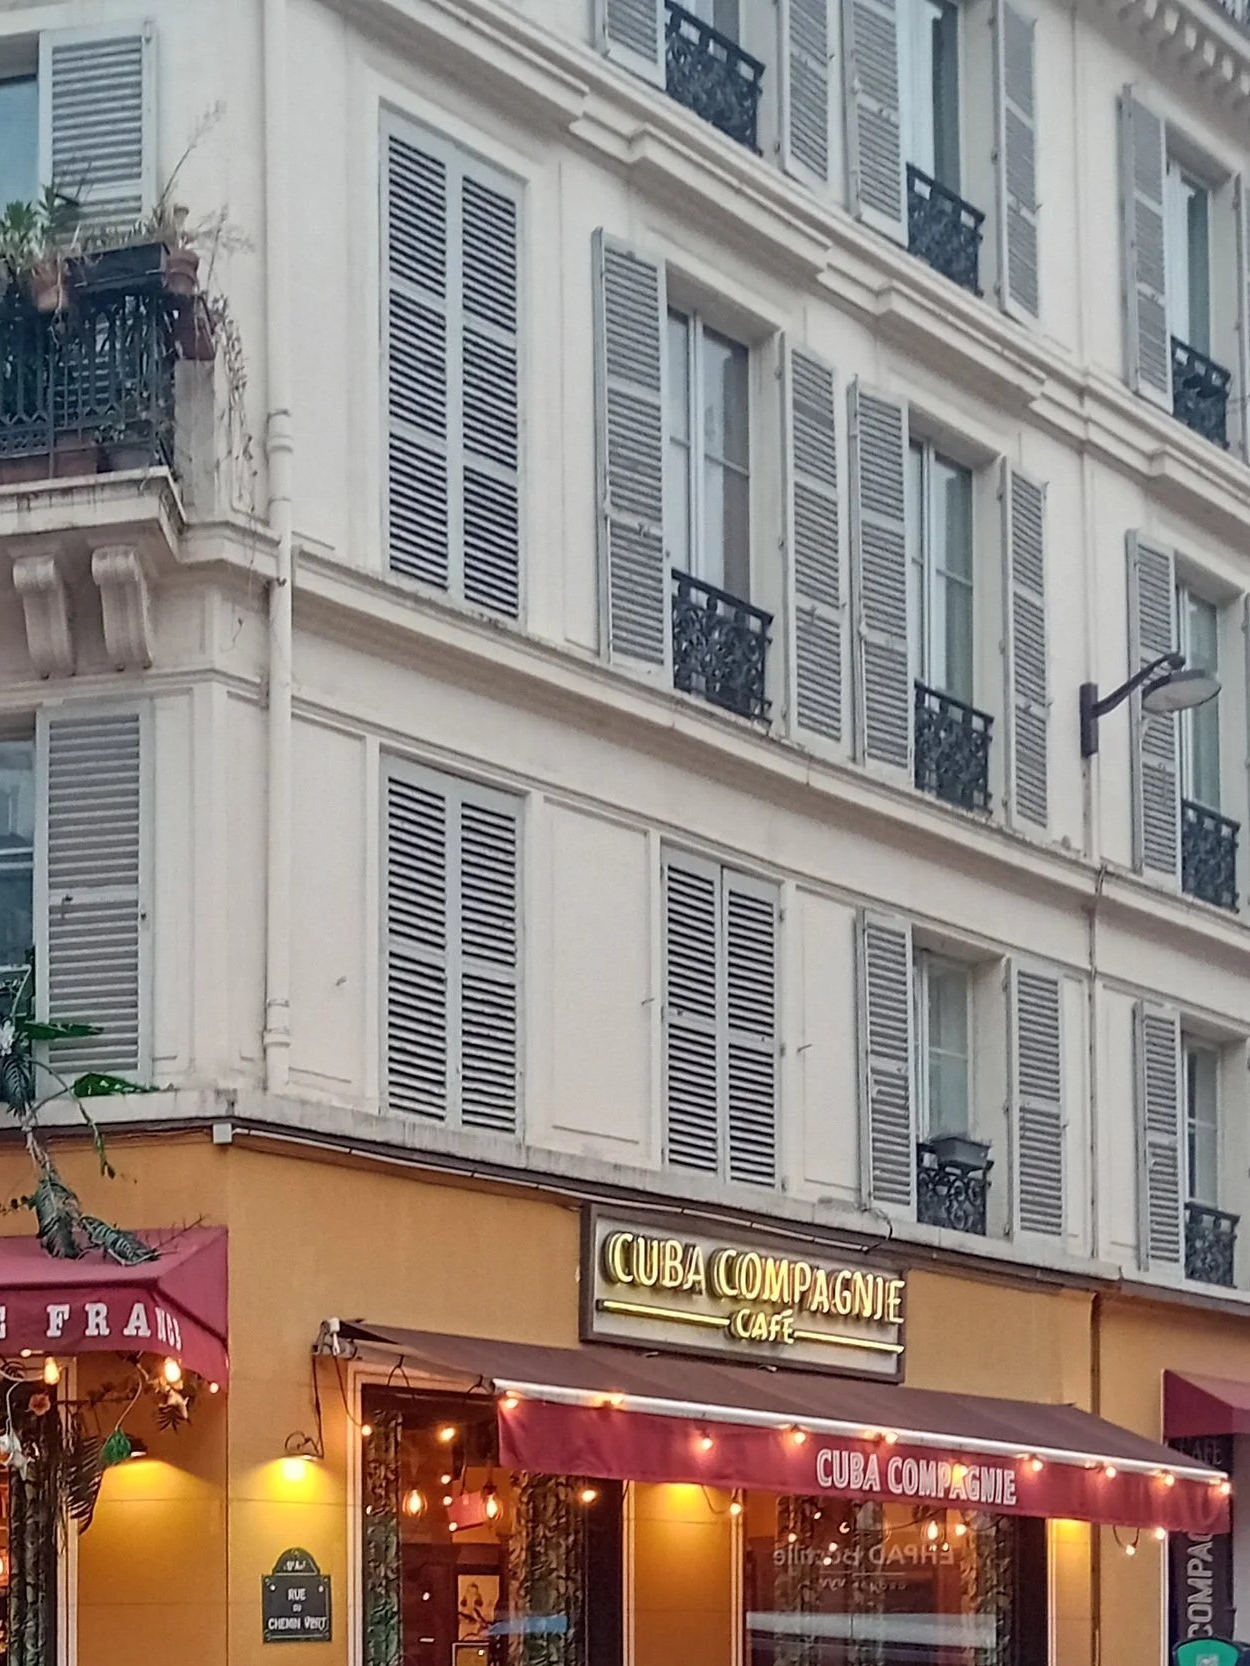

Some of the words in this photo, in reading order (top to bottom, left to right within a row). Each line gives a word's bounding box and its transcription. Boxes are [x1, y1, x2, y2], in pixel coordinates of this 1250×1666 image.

[607, 1231, 706, 1294] CUBA
[710, 1248, 906, 1324] COMPAGNIE
[733, 1308, 795, 1345] CAFÉ
[816, 1448, 881, 1492] CUBA
[887, 1456, 1018, 1505] COMPAGNIE
[287, 1588, 307, 1601] RUE
[1187, 1532, 1213, 1638] COMPA
